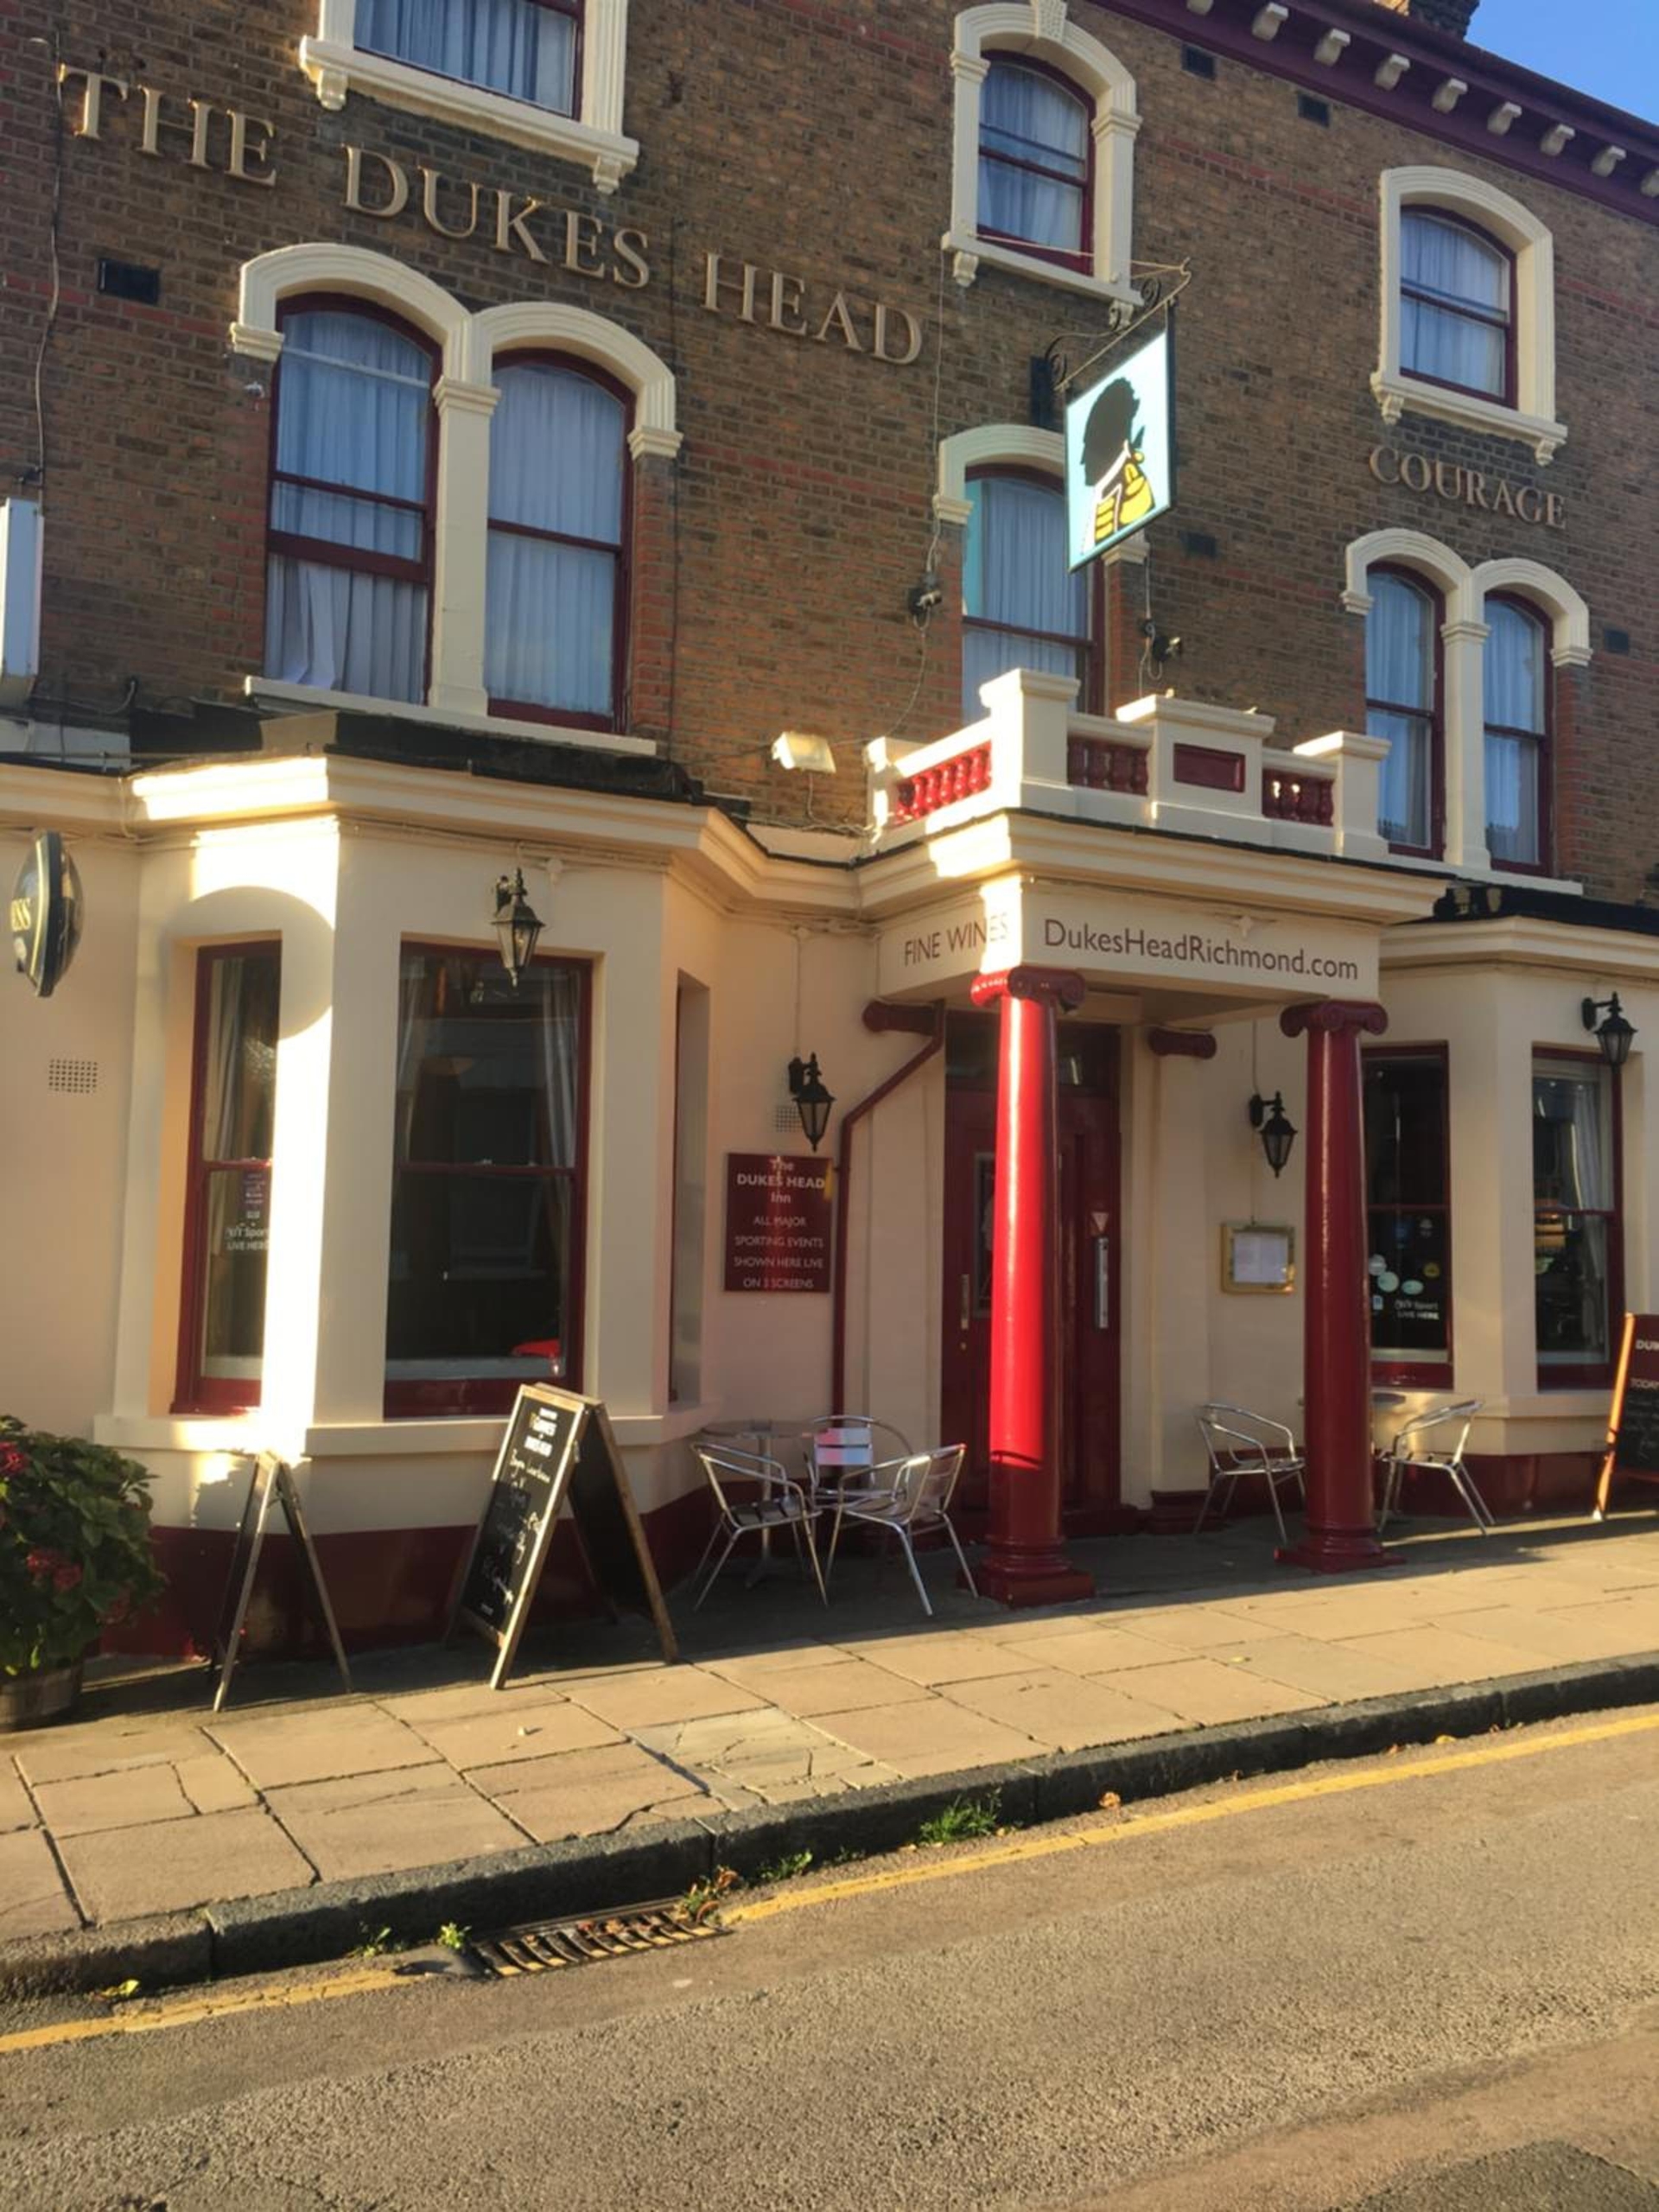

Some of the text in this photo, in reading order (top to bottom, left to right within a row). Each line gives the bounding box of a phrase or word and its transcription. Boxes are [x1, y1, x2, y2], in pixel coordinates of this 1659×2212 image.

[60, 64, 924, 365] THE DUKES HEAD
[1369, 444, 1567, 530] COURAGE
[904, 912, 1010, 967] FINE WINES
[1044, 918, 1359, 981] DukesHeadRichmond.com
[736, 1173, 825, 1189] DUKES HEAD
[753, 1217, 807, 1228] ALL MAJOR
[734, 1236, 824, 1249] SPORTING EVENTS
[734, 1256, 824, 1269] SHOWN HERE LIVE
[742, 1277, 761, 1287] ON
[770, 1278, 814, 1289] SCREENS
